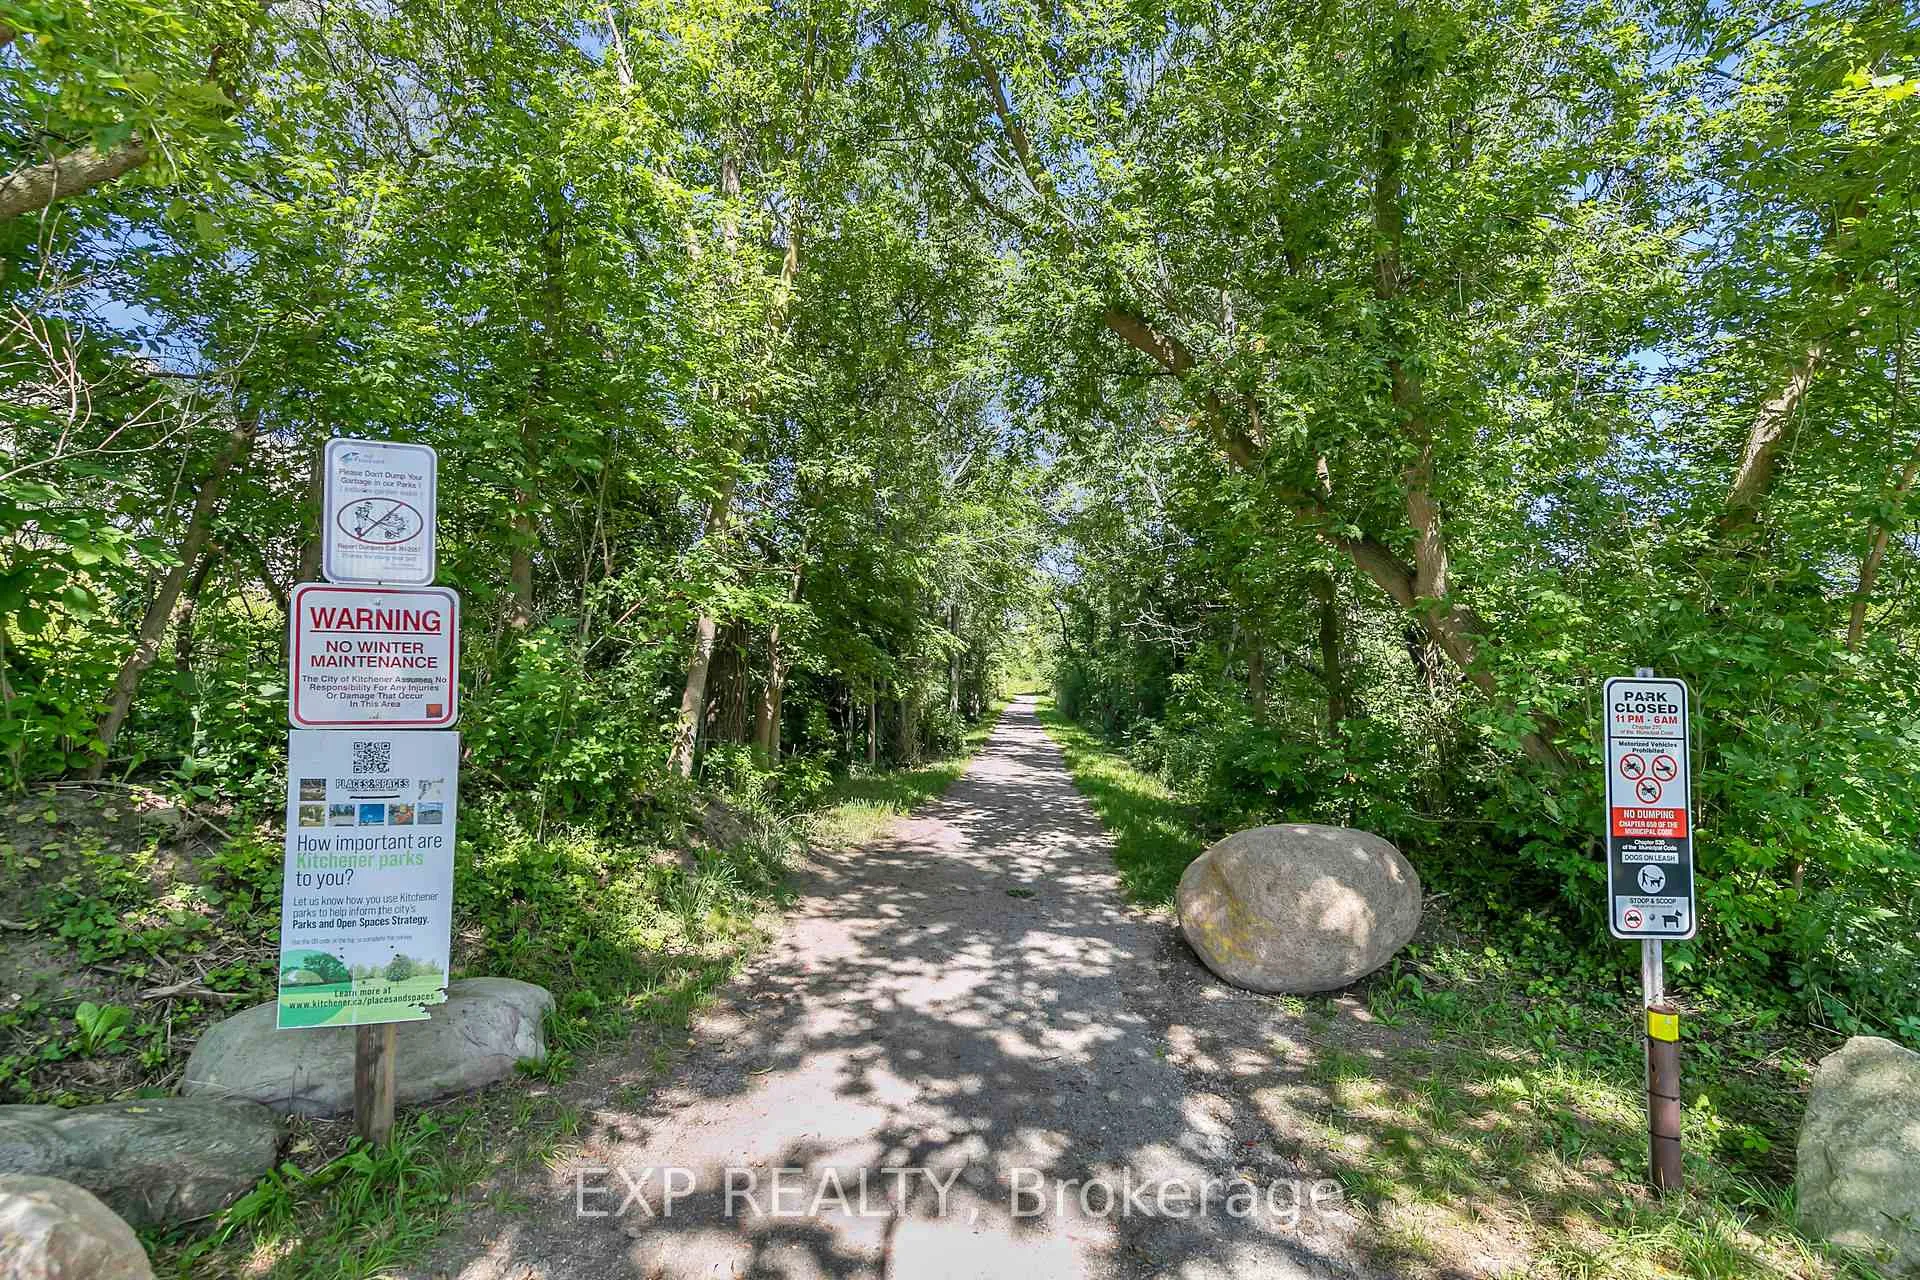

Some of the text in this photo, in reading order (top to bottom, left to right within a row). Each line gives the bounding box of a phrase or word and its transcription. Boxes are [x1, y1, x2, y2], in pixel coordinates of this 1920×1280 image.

[340, 477, 372, 486] Garbage
[385, 472, 406, 480] Dump
[408, 472, 422, 480] Your
[309, 607, 441, 632] WARNING
[326, 640, 424, 654] NO WINTER
[311, 655, 438, 668] MAINTENANCE
[321, 675, 338, 684] City
[310, 684, 370, 692] Responsibility
[390, 684, 406, 692] Any
[408, 684, 439, 692] Injuries
[340, 692, 375, 700] Damage
[1624, 692, 1668, 702] PARK
[1614, 703, 1678, 714] CLOSED
[1616, 714, 1624, 722] 11
[1628, 714, 1644, 722] PM
[336, 778, 410, 790] PLACES&SPACES
[1624, 810, 1674, 818] NO DUMPING
[298, 834, 442, 853] How important are
[297, 851, 424, 870] Kitchener parks
[296, 869, 354, 889] to you?
[294, 892, 438, 906] Let us know how you use Kitchener
[293, 904, 416, 918] parks to help inform the city's
[292, 914, 430, 930] Parks and Open Spaces Strategy.
[334, 986, 391, 998] Learn more at
[289, 993, 435, 1009] www.kitchener.ca/placesandspaces
